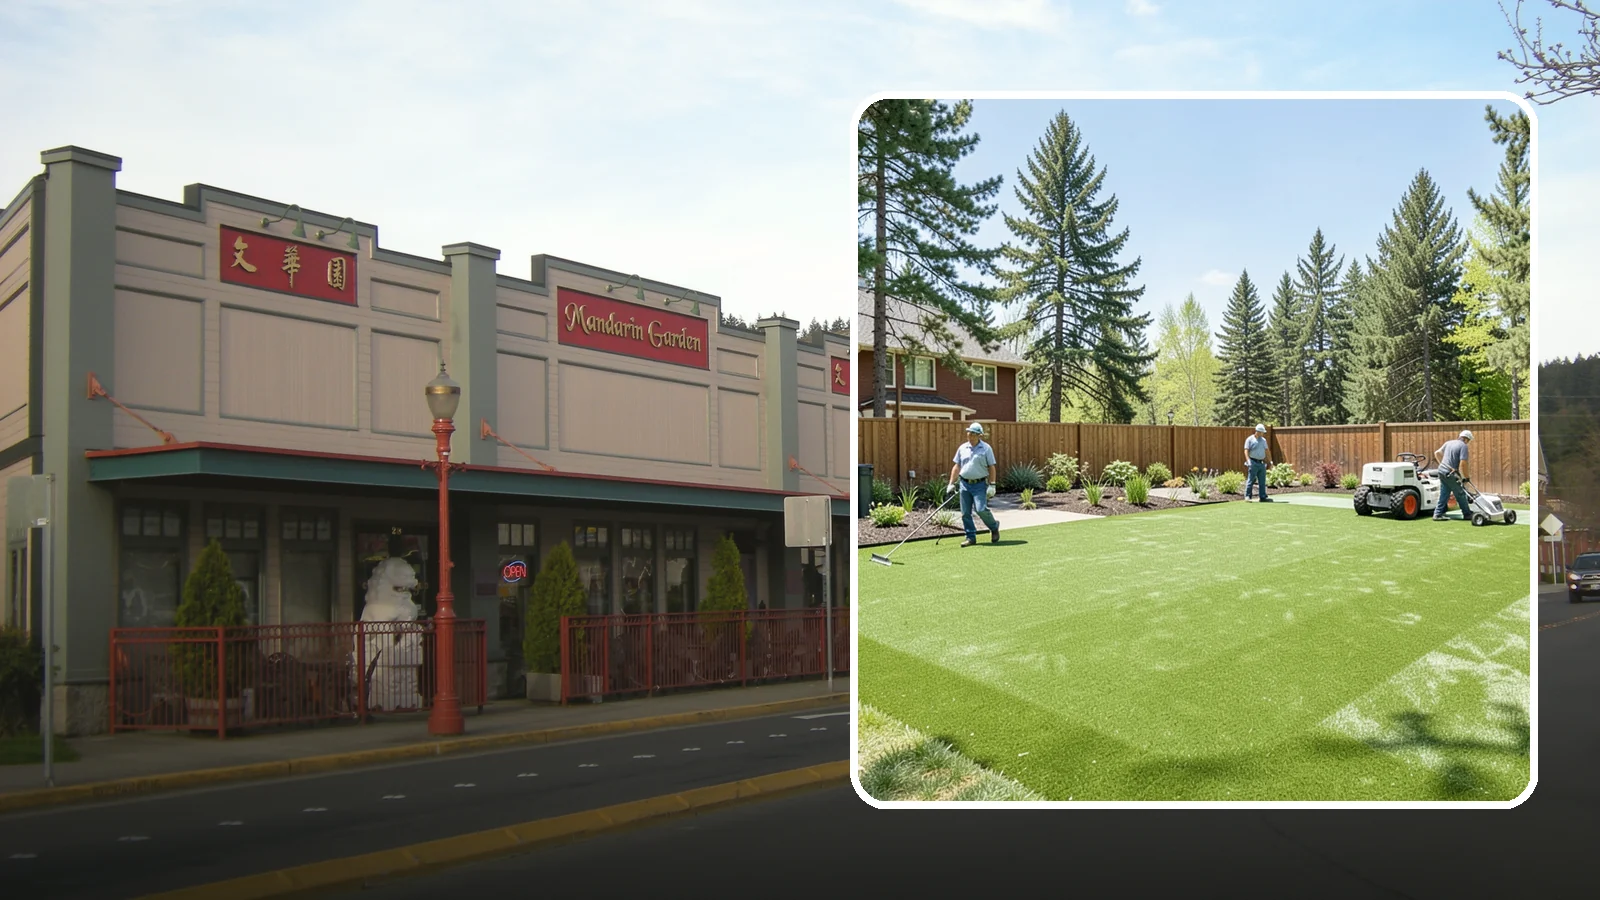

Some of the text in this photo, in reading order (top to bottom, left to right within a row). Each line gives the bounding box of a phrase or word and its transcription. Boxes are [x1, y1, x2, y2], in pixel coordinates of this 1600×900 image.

[230, 235, 346, 291] 文華園
[564, 302, 702, 352] Mandarin Garden
[503, 565, 527, 578] OPEN
